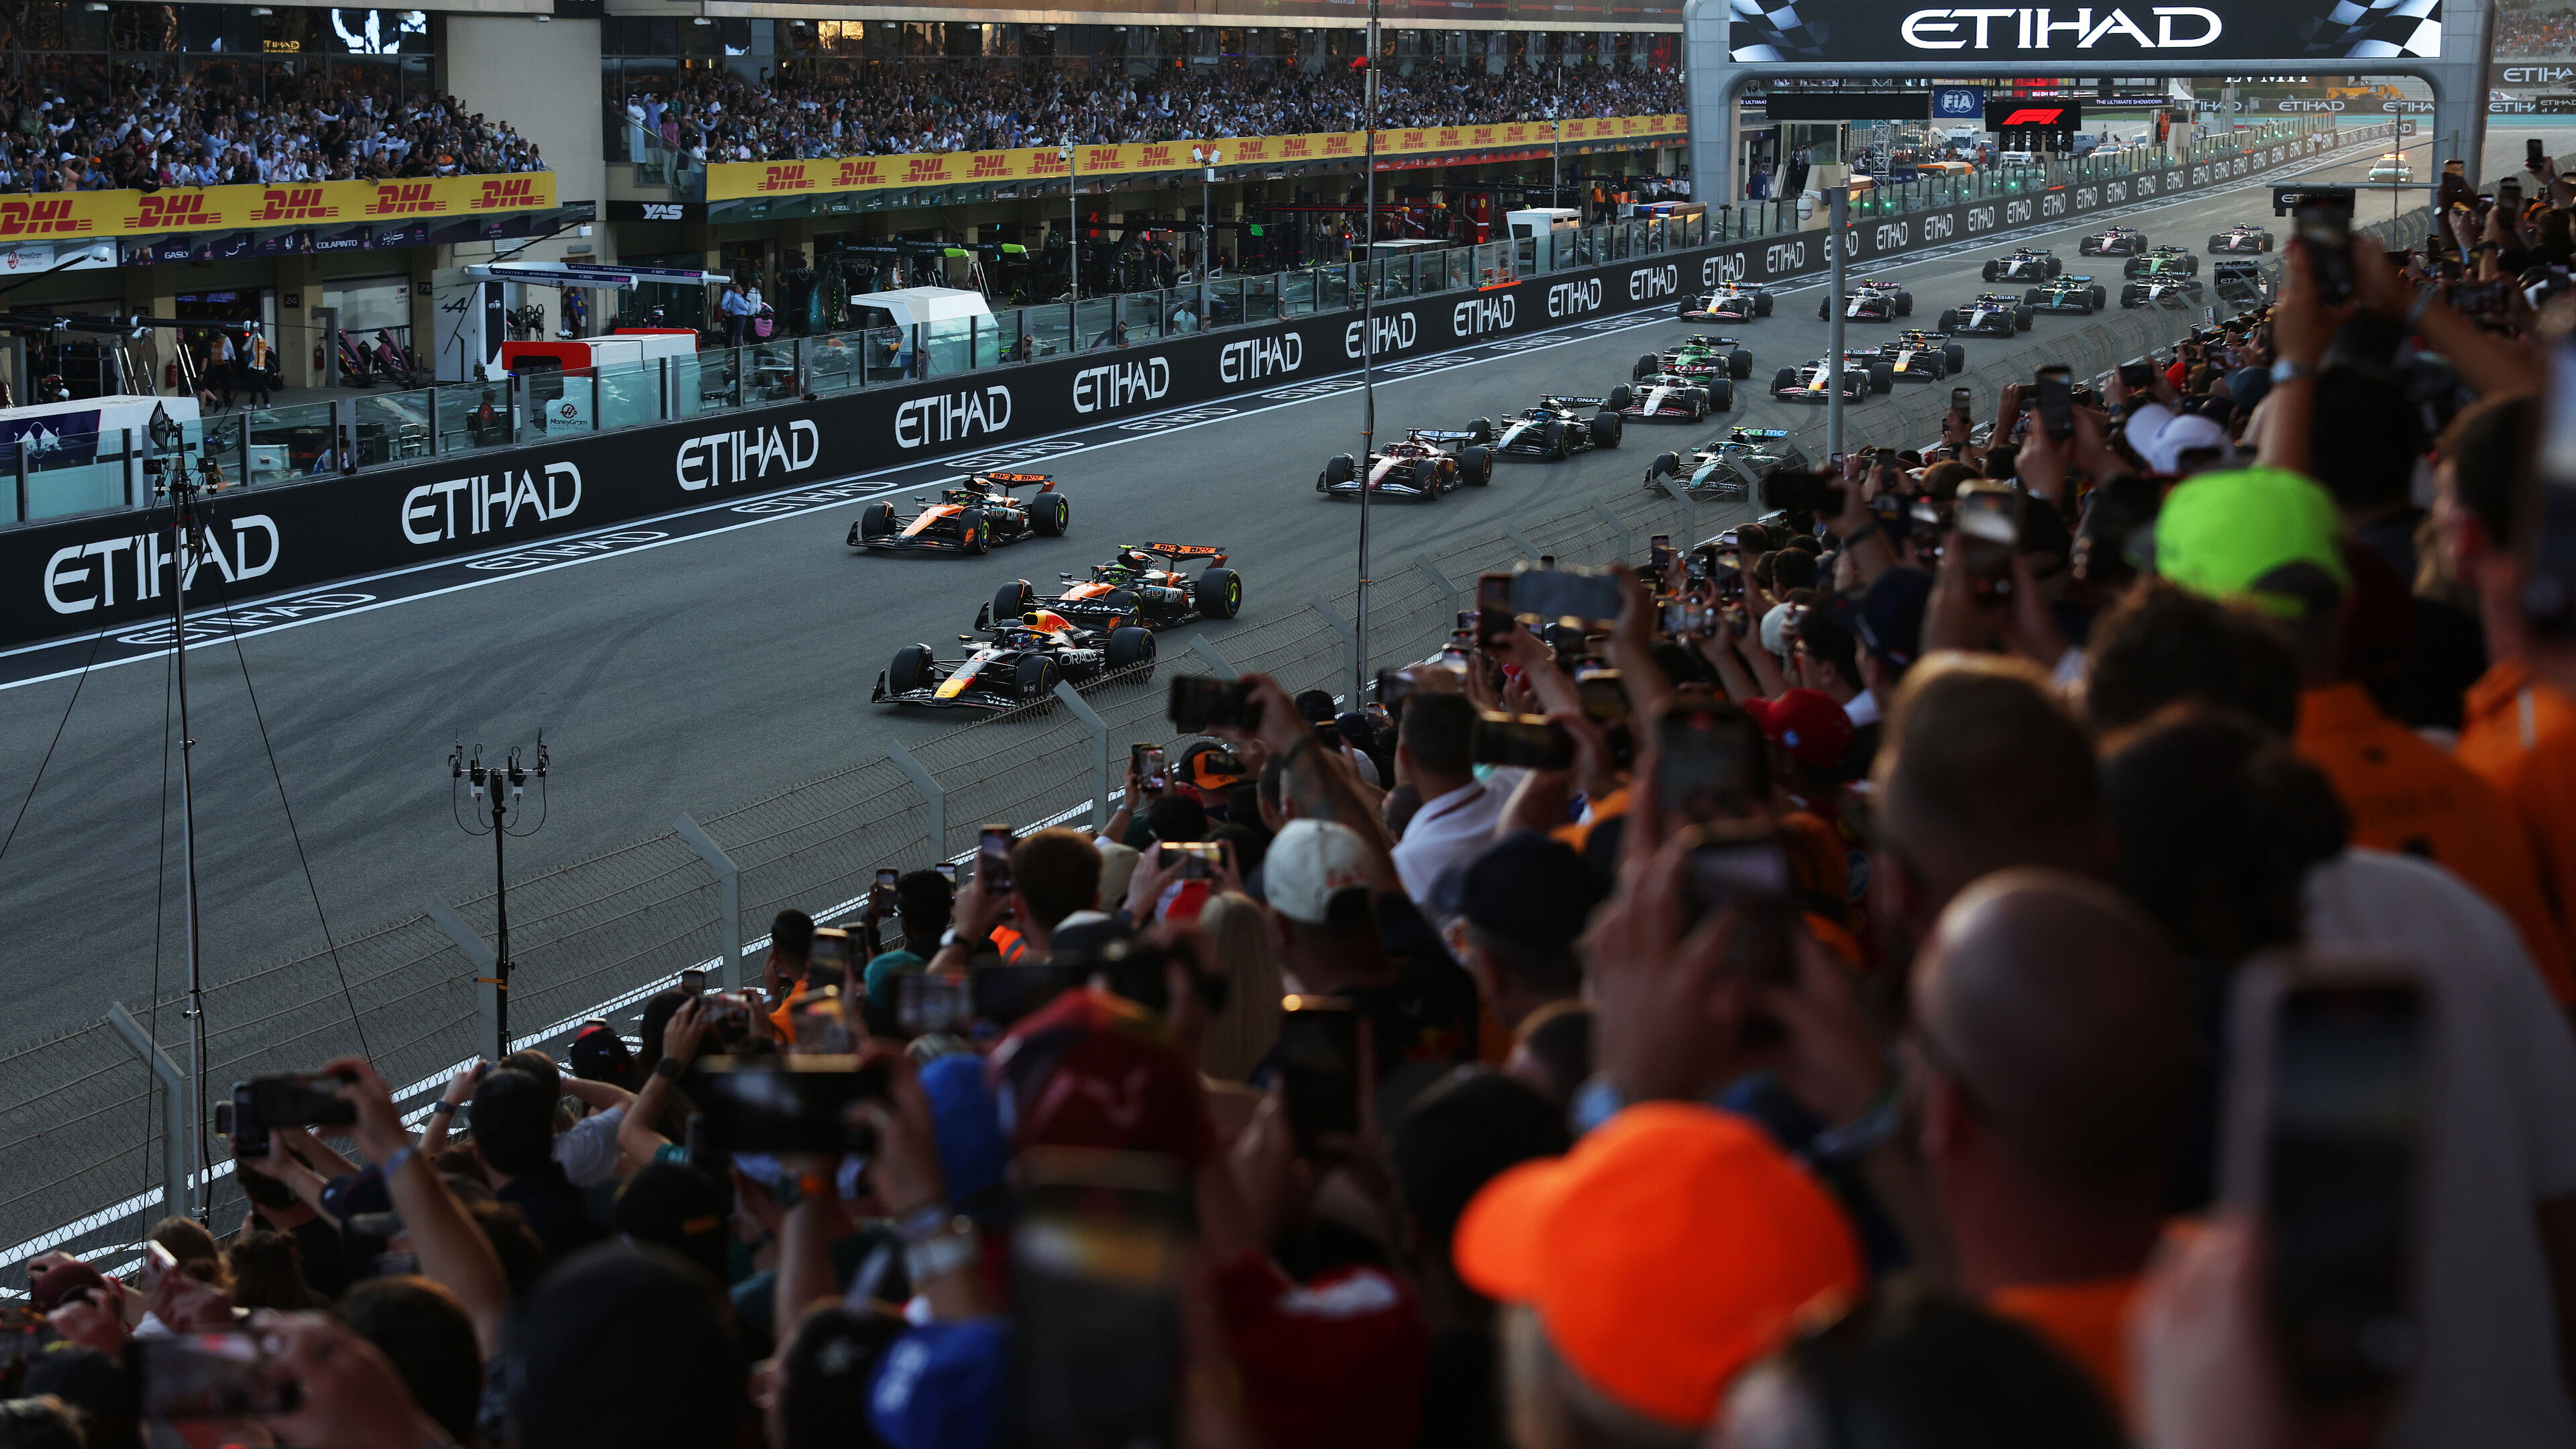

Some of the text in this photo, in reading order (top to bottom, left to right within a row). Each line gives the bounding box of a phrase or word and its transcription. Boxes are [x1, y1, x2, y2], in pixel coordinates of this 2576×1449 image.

[1900, 8, 2224, 50] ETIHAD
[263, 40, 300, 50] TIHAD
[2503, 67, 2576, 83] ETIHA
[2278, 101, 2345, 111] ETIHAD
[2383, 101, 2434, 112] ETIHA
[2489, 102, 2536, 113] ETIH
[1507, 126, 1524, 142] DHL
[1568, 123, 1585, 137] DHL
[1597, 121, 1611, 136] DHL
[1650, 117, 1664, 132] DHL
[1326, 136, 1348, 155] DHL
[1404, 131, 1423, 150] DHL
[1440, 129, 1458, 147] DHL
[1474, 128, 1492, 146] DHL
[1089, 149, 1120, 170] DHL
[1142, 146, 1170, 168] DHL
[1239, 141, 1264, 160] DHL
[1284, 138, 1307, 159] DHL
[2272, 145, 2285, 164] ETIHAD
[2290, 141, 2302, 158] ETIHAD
[909, 158, 945, 182] DHL
[973, 155, 1007, 177] DHL
[1033, 152, 1065, 174] DHL
[2215, 161, 2230, 180] ETIHAD
[2233, 158, 2248, 175] ETIHAD
[2253, 151, 2267, 169] ETIHAD
[766, 165, 807, 191] DHL
[840, 162, 879, 186] DHL
[2167, 170, 2184, 190] ETIHAD
[2192, 165, 2210, 185] ETIHAD
[482, 179, 535, 208] DHL
[2107, 180, 2127, 203] ETIHAD
[2137, 175, 2156, 197] ETIHAD
[262, 189, 327, 221] DHL
[377, 184, 436, 214] DHL
[2043, 192, 2066, 217] ETIHAD
[2076, 186, 2098, 209] ETIHAD
[0, 199, 78, 235] DHL
[137, 195, 207, 228] DHL
[642, 204, 684, 220] YAS
[1968, 205, 1994, 232] ETIHAD
[2006, 199, 2031, 224] ETIHAD
[1876, 221, 1908, 250] ETIHAD
[1925, 213, 1953, 241] ETIHAD
[164, 251, 190, 259] GASLY
[317, 239, 358, 250] COLAPINTO
[1824, 231, 1859, 262] EAD
[1766, 241, 1805, 273] ETIHAD
[1703, 252, 1746, 287] ETIHAD
[2220, 276, 2256, 284] ETIHD
[1629, 264, 1678, 302] ETIHAD
[1548, 277, 1602, 319] ETIHAD
[1454, 294, 1515, 337] ETIHAD
[1489, 335, 1572, 351] ETIHAD
[1220, 332, 1302, 383] ETIHAD
[1383, 356, 1475, 374] ETIHAD
[1073, 356, 1170, 413] ETIHAD
[1261, 380, 1365, 400] ETIHAD
[895, 385, 1012, 449] ETIHAD
[1118, 408, 1238, 430] ETIHAD
[676, 419, 820, 491] ETIHAD
[945, 441, 1085, 468] ETIHAD
[402, 462, 582, 545] ETIHAD
[731, 481, 899, 514] ETIHAD
[465, 531, 669, 570] ETIHAD
[44, 514, 280, 614] ETIHAD
[117, 592, 377, 645] ETIHAD
[1073, 631, 1087, 640] HOND
[1060, 651, 1098, 666] ORACLE
